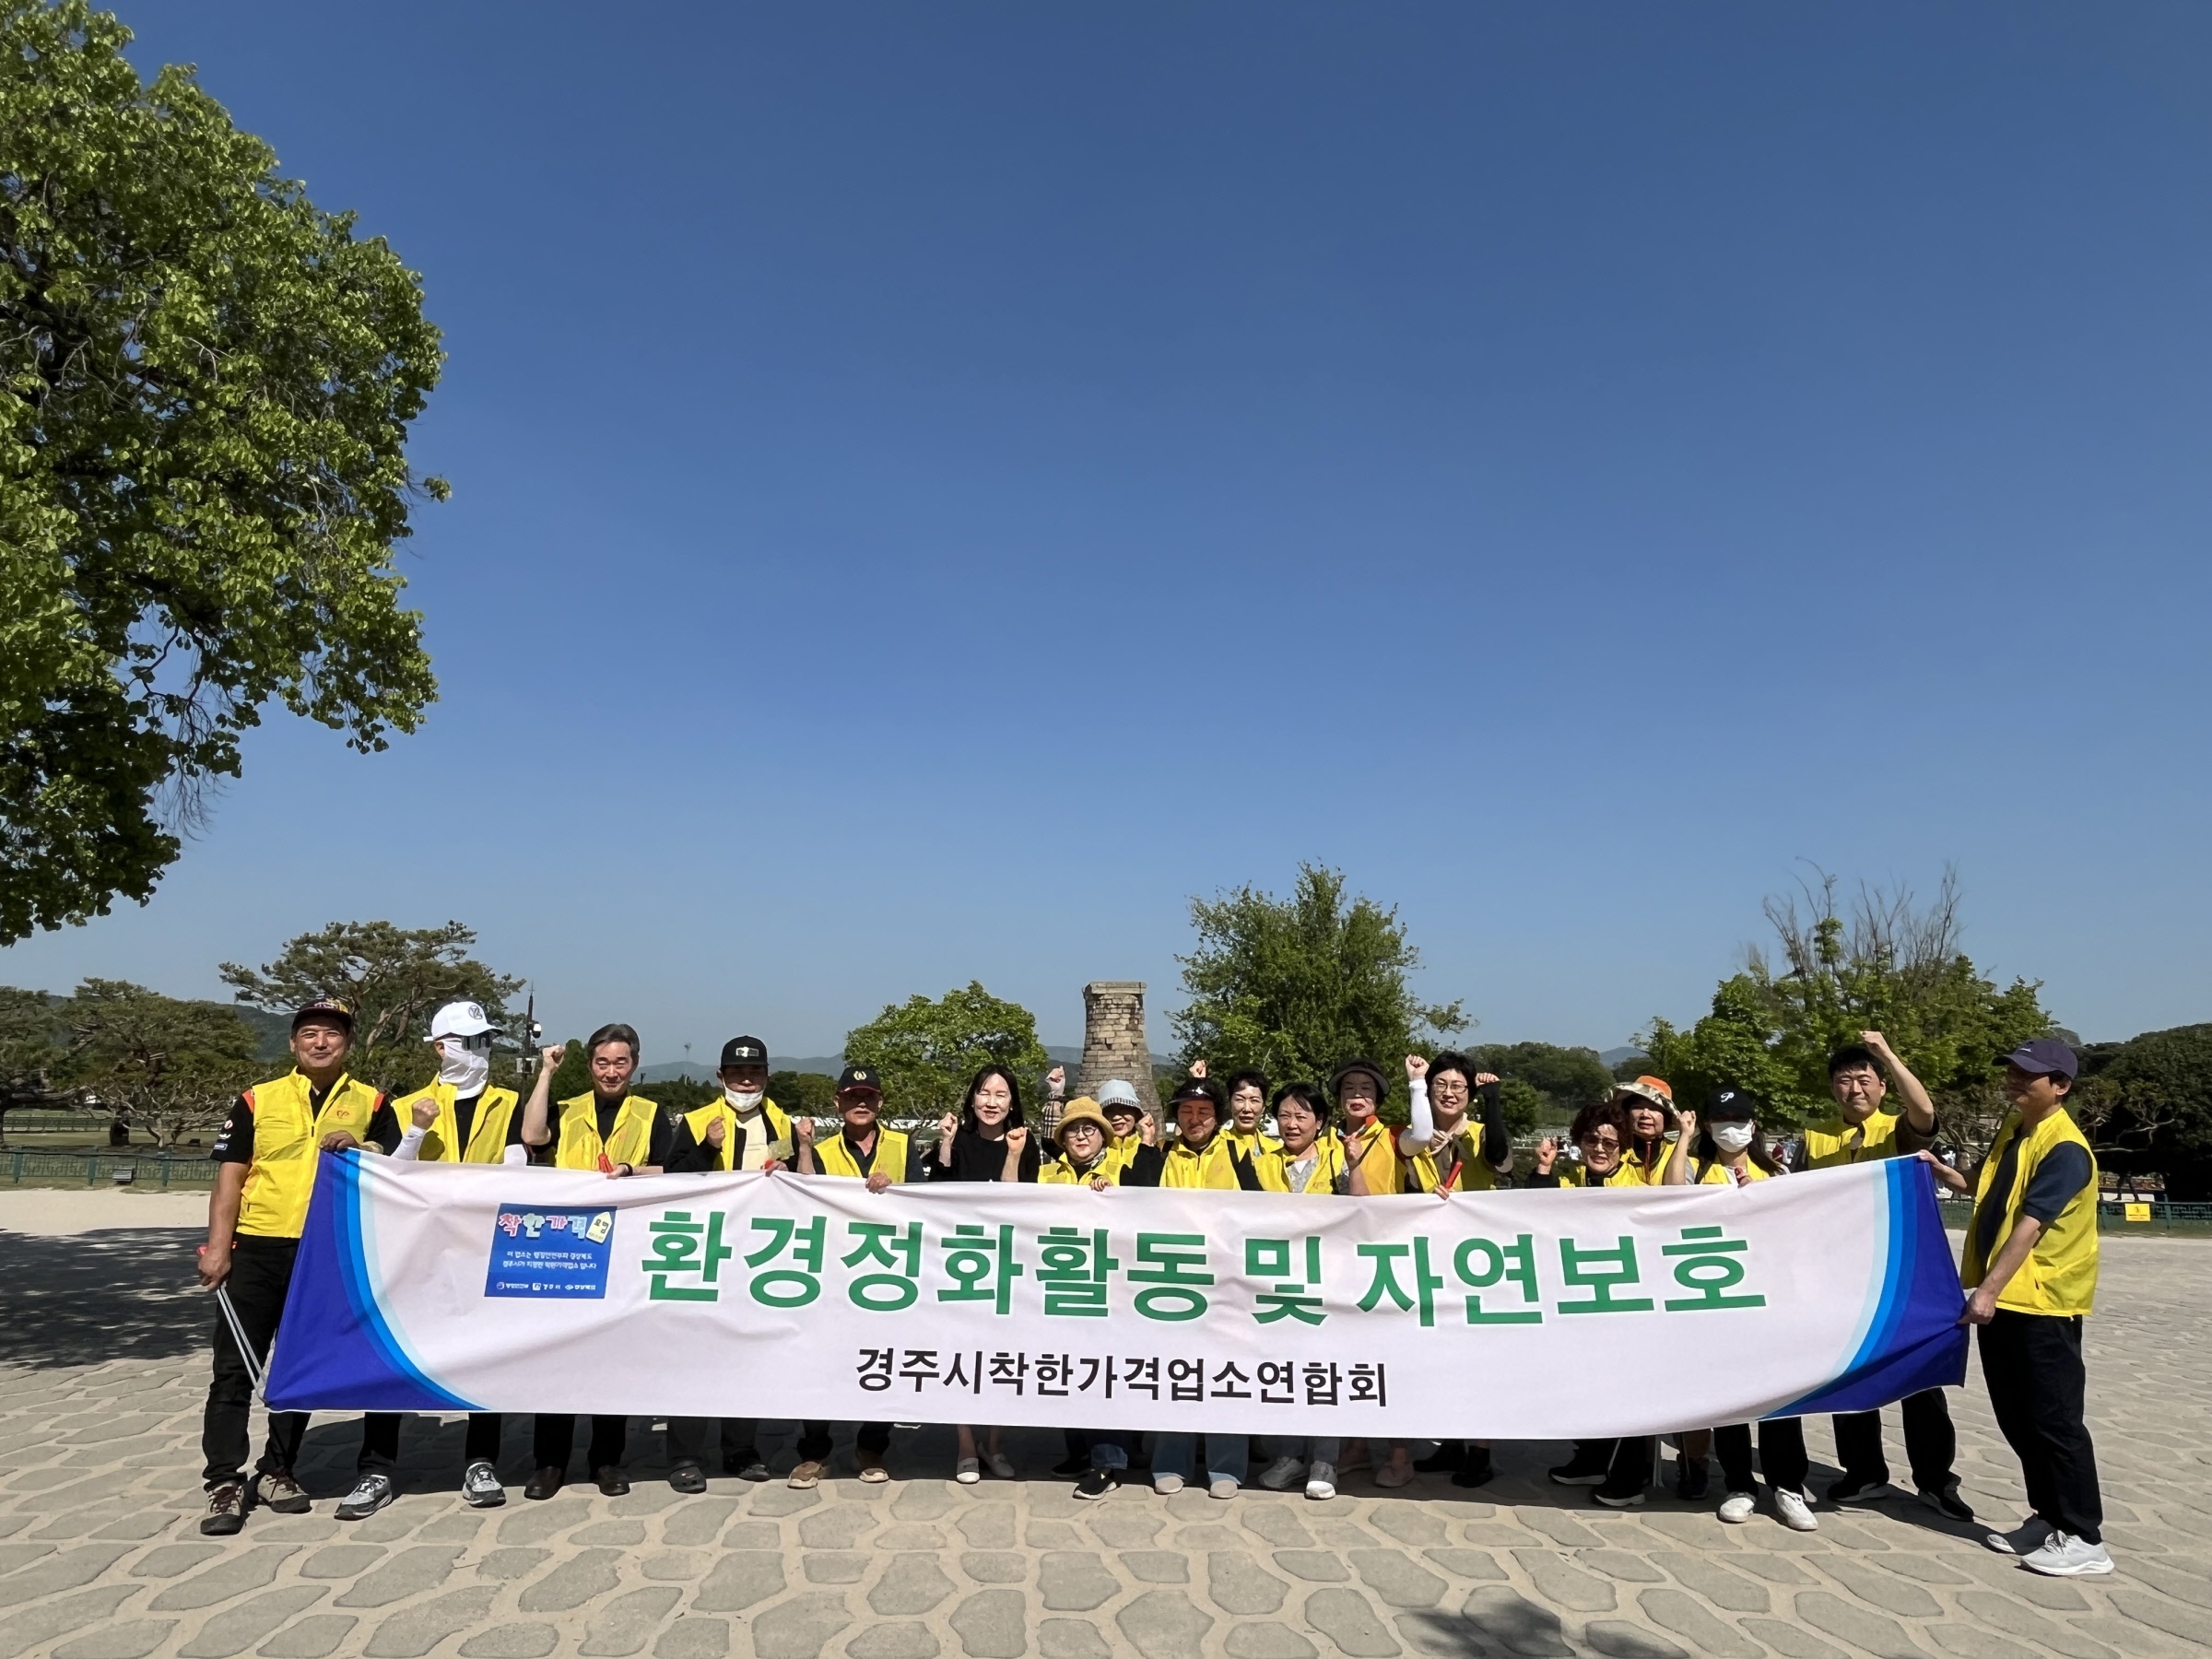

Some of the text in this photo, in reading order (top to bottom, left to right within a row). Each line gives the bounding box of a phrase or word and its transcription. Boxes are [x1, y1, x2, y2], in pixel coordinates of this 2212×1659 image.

[641, 1210, 1767, 1327] 환경정화활동 및 자연보호
[855, 1346, 1387, 1407] 경주시착한가격업소연합회
